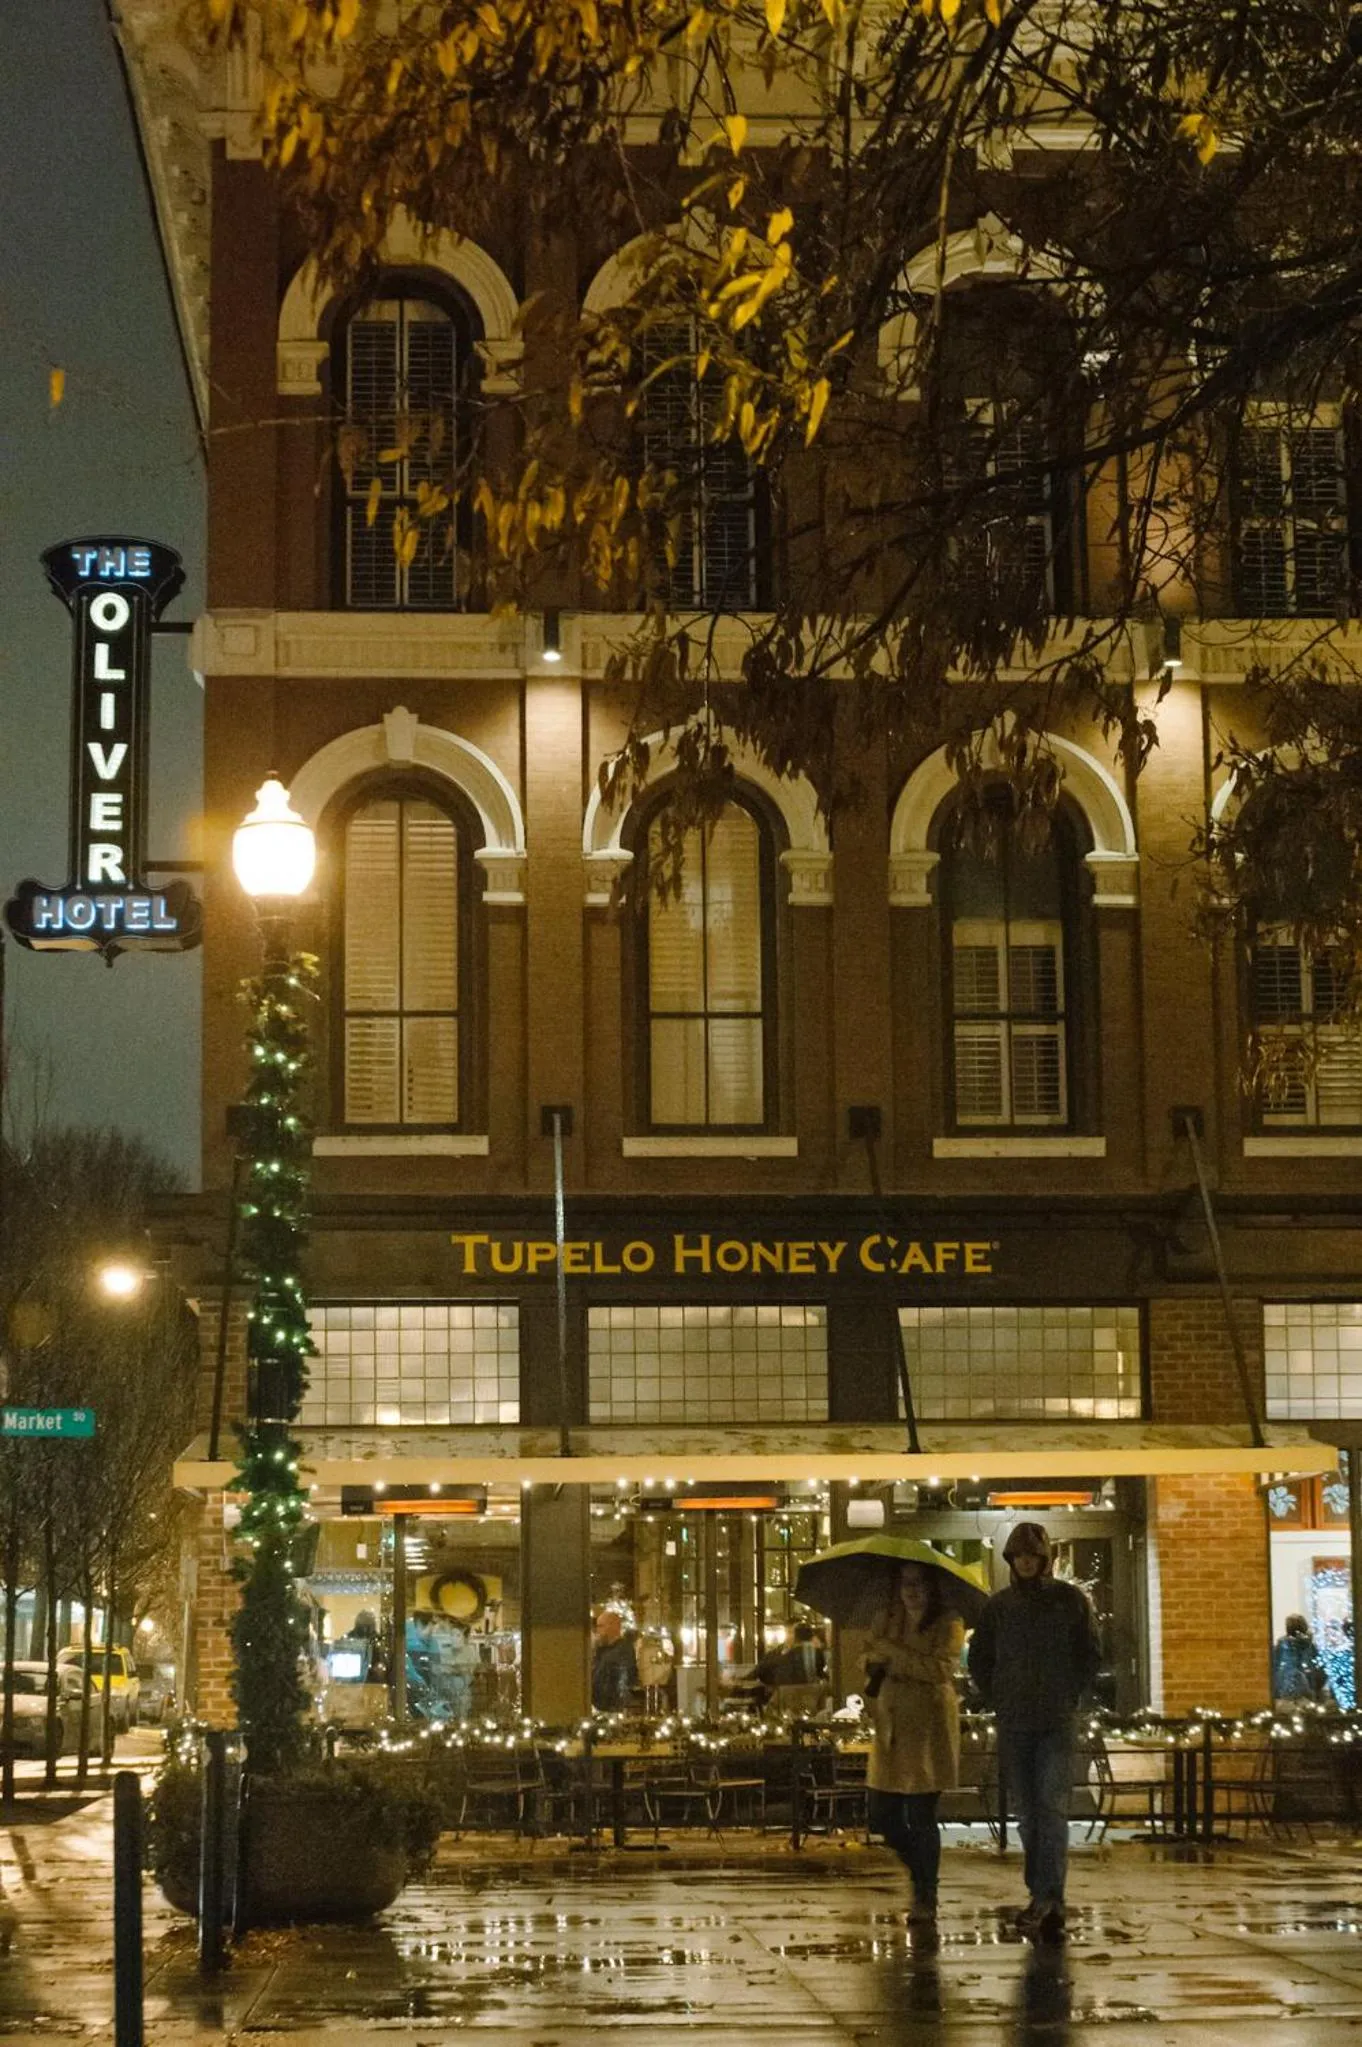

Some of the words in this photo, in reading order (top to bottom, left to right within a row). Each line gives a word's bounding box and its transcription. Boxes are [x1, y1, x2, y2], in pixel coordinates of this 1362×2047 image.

[72, 547, 151, 577] THE
[87, 592, 130, 883] OLIVER
[33, 897, 177, 930] HOTEL
[451, 1234, 655, 1273] TUPELO
[673, 1234, 848, 1273] HONEY
[4, 1411, 63, 1430] Market
